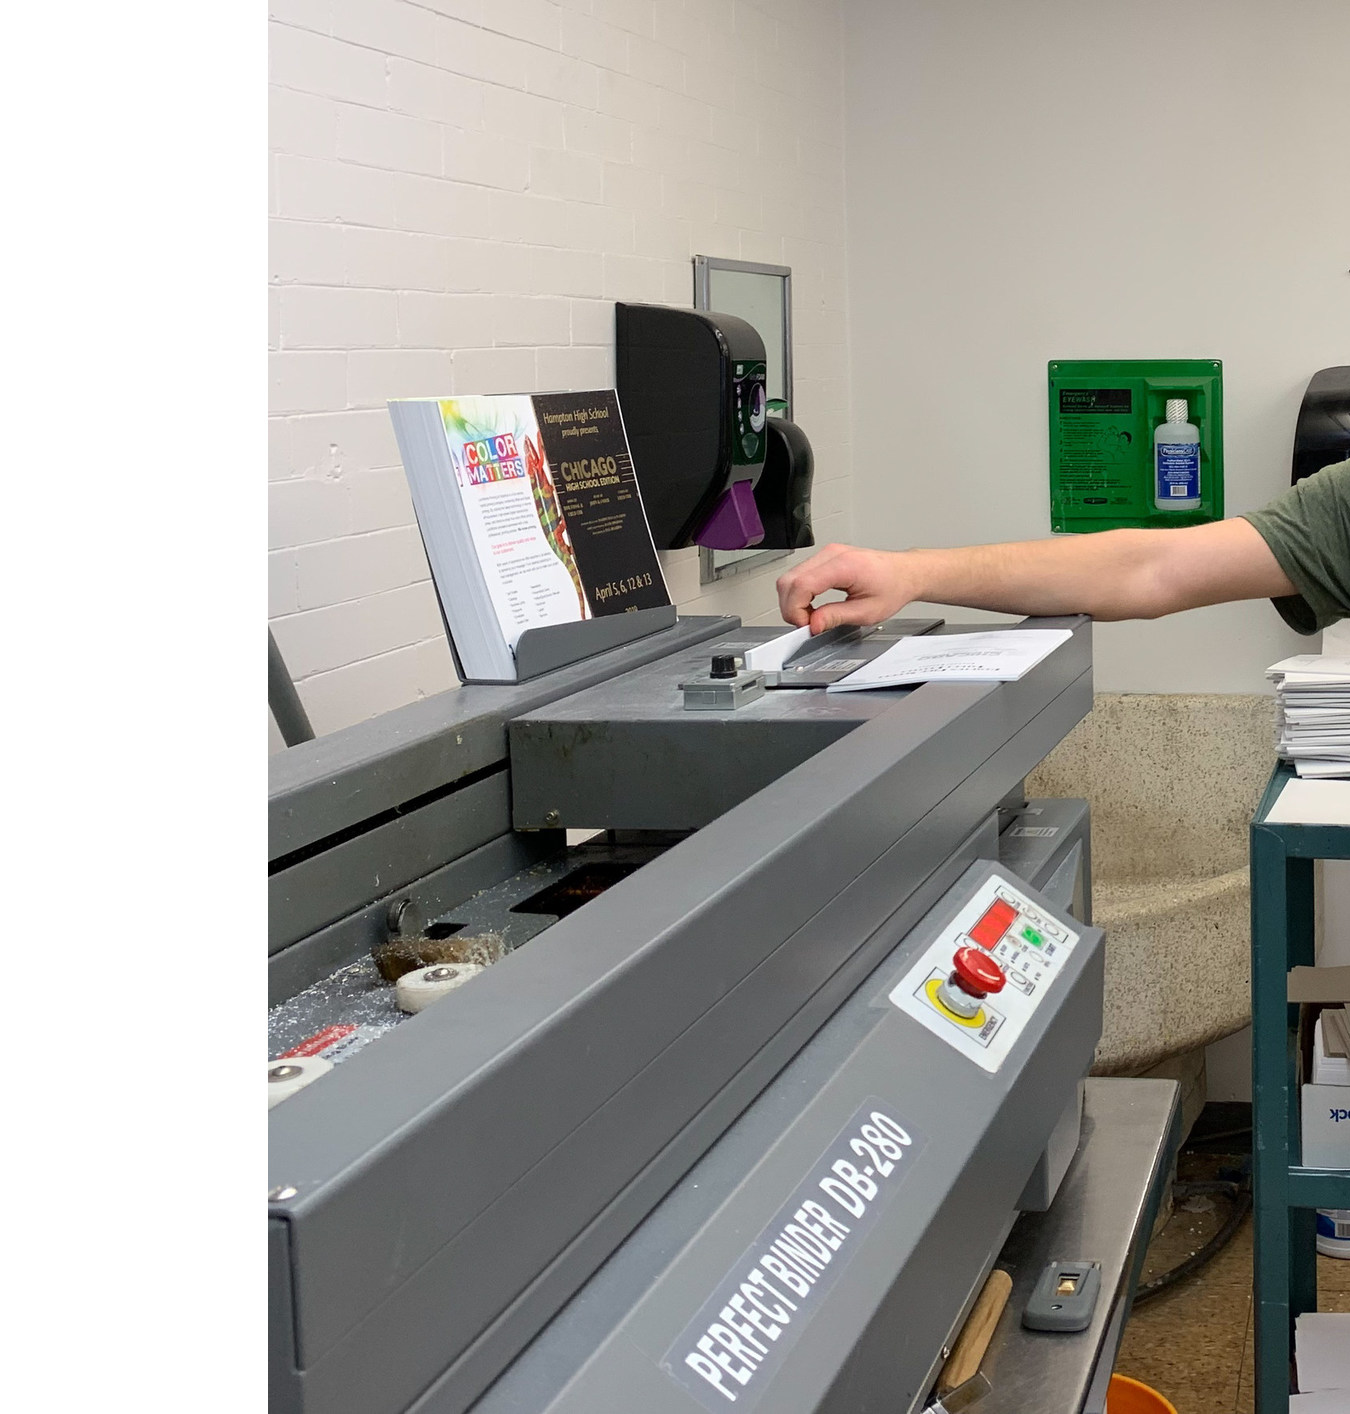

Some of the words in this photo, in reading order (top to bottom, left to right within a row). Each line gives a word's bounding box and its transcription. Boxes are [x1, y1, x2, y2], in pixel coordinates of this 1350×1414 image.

[543, 412, 573, 425] Hampton
[573, 409, 588, 423] High
[589, 406, 609, 419] School
[561, 426, 580, 439] proudly
[466, 435, 518, 464] COLOR
[467, 460, 525, 484] MATTERS
[560, 456, 617, 481] CHICAGO
[565, 482, 580, 492] HIGH
[579, 479, 600, 490] SCHOOL
[600, 476, 620, 487] EDITION
[595, 583, 613, 603] April
[612, 582, 621, 596] 5,
[620, 579, 628, 594] 6,
[627, 577, 637, 590] 12
[636, 575, 643, 588] &
[643, 572, 653, 586] 13
[685, 1269, 798, 1402] PERFECT
[759, 1199, 851, 1298] BINDER
[818, 1111, 913, 1219] DB-280
